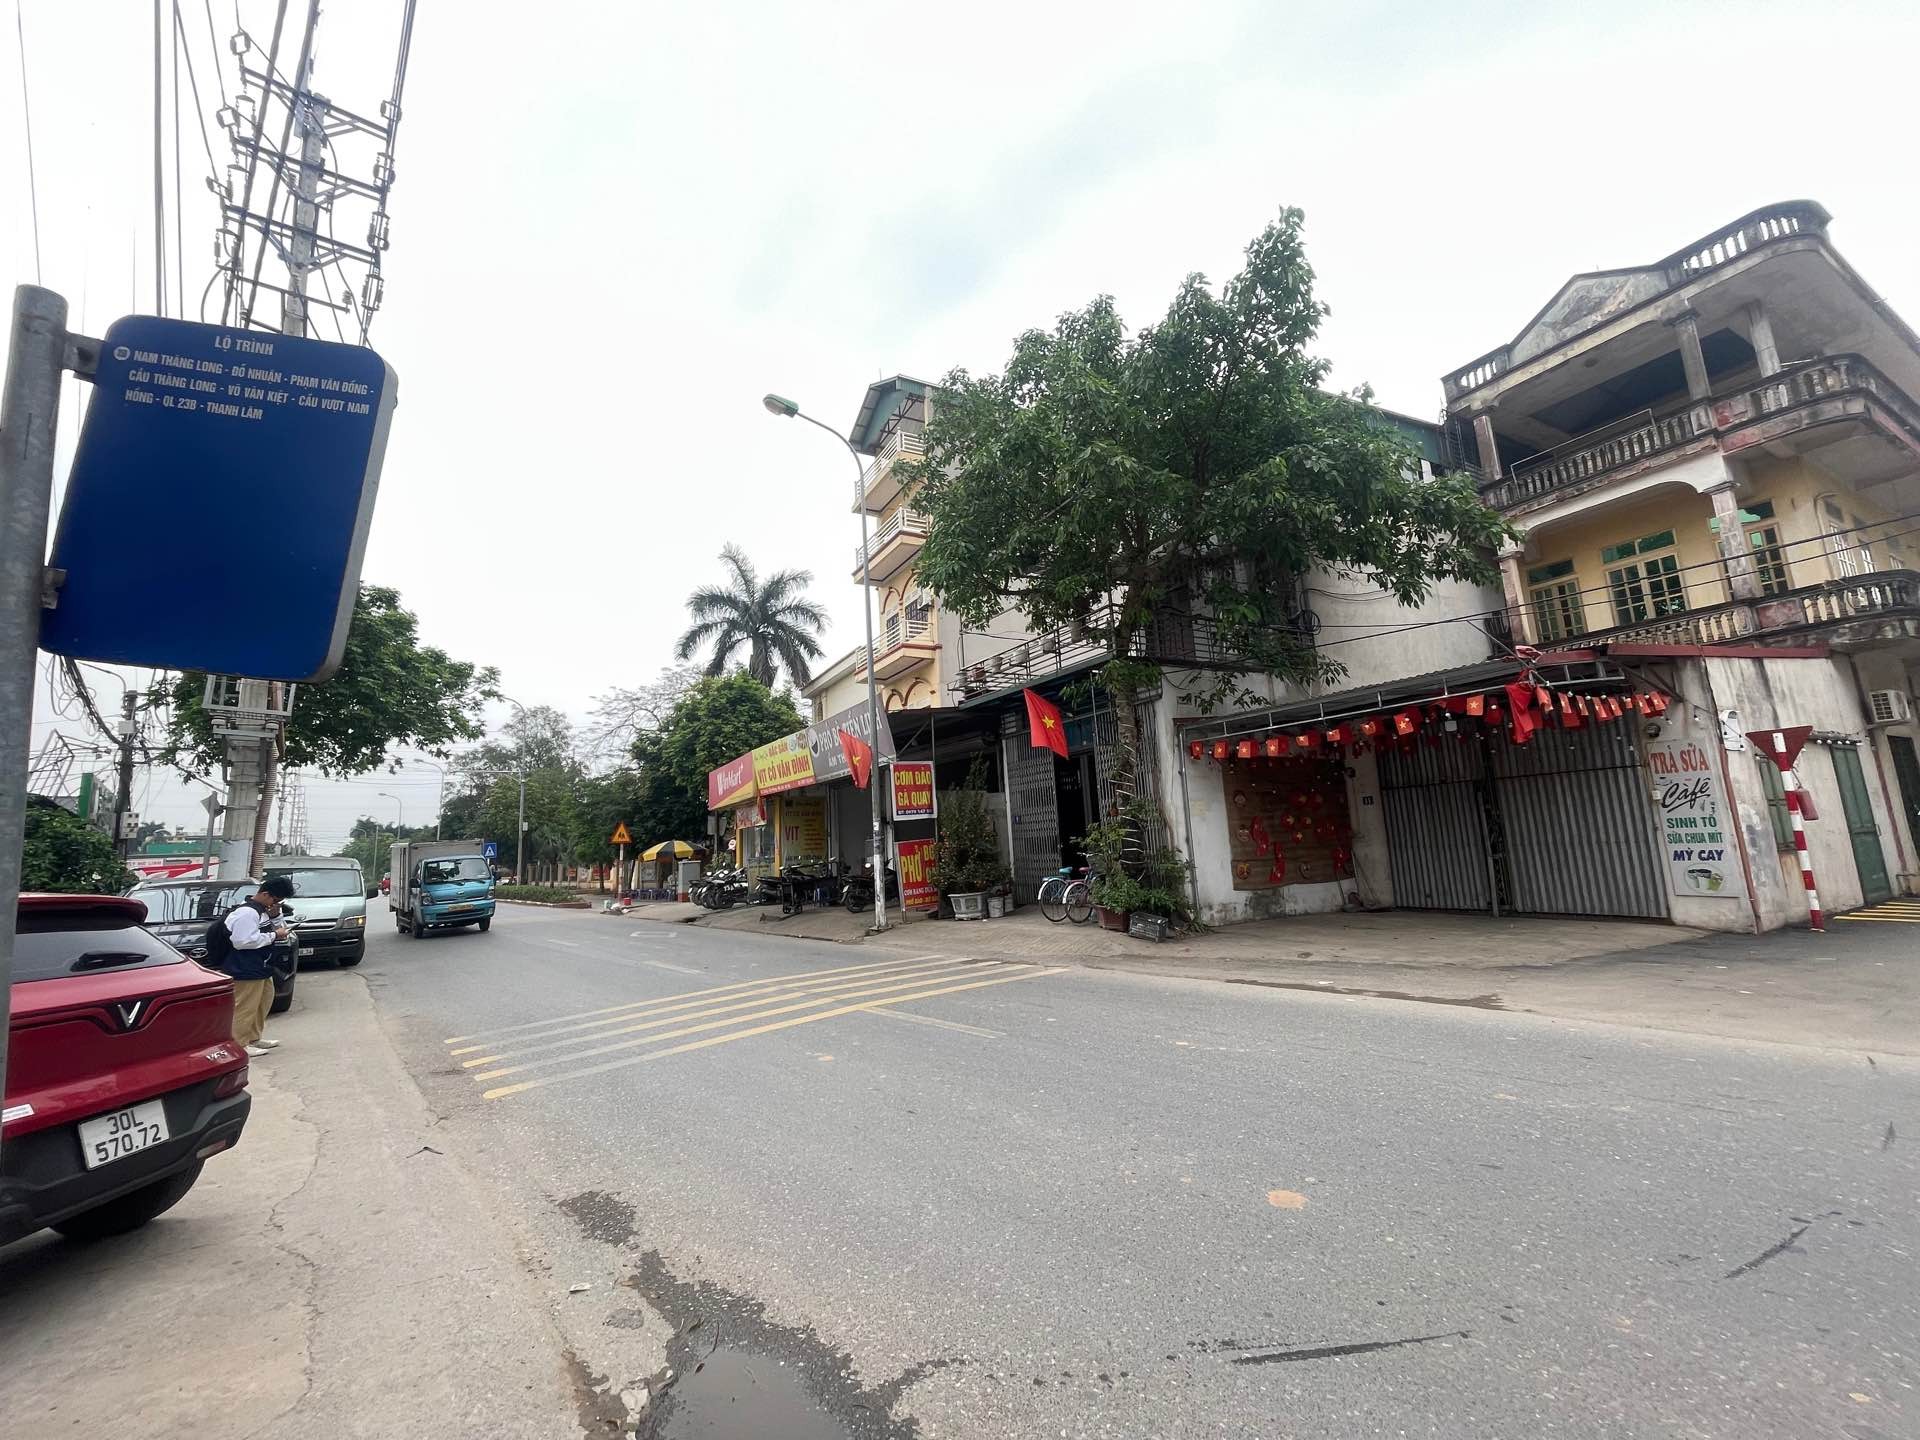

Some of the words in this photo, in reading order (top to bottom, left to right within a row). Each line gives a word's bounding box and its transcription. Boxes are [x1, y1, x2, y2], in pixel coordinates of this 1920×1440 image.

[215, 335, 231, 352] LỘ
[235, 338, 274, 356] TRÌNH
[133, 350, 159, 364] NAM
[161, 353, 194, 370] THĂNG
[196, 360, 223, 374] LONG
[247, 367, 283, 385] NHUẬN
[290, 374, 319, 390] PHẠM
[321, 377, 340, 391] VĂN
[341, 380, 368, 395] ĐỒNG
[125, 387, 154, 404] HỒNG
[162, 395, 175, 408] QL
[177, 397, 197, 411] 23B
[206, 401, 239, 417] THANH
[240, 405, 264, 420] LÂM
[128, 368, 150, 383] CẦU
[153, 372, 187, 389] THĂNG
[189, 378, 217, 393] LONG
[227, 383, 241, 397] VÕ
[244, 386, 264, 400] VĂN
[267, 390, 289, 405] KIỆT
[298, 393, 318, 408] CẦU
[321, 399, 345, 413] VƯỢT
[347, 401, 370, 415] NAM
[1650, 745, 1680, 774] TRÀ
[1680, 743, 1710, 772] SỮA
[894, 770, 914, 785] CƠM
[897, 789, 910, 806] GÀ
[911, 791, 931, 807] QUAY
[1666, 816, 1698, 828] SINH
[900, 845, 923, 884] PHỞ
[1672, 847, 1694, 861] MỲ
[1697, 849, 1725, 861] CAY
[106, 1110, 144, 1135] 30L
[95, 1123, 163, 1162] 570.72
